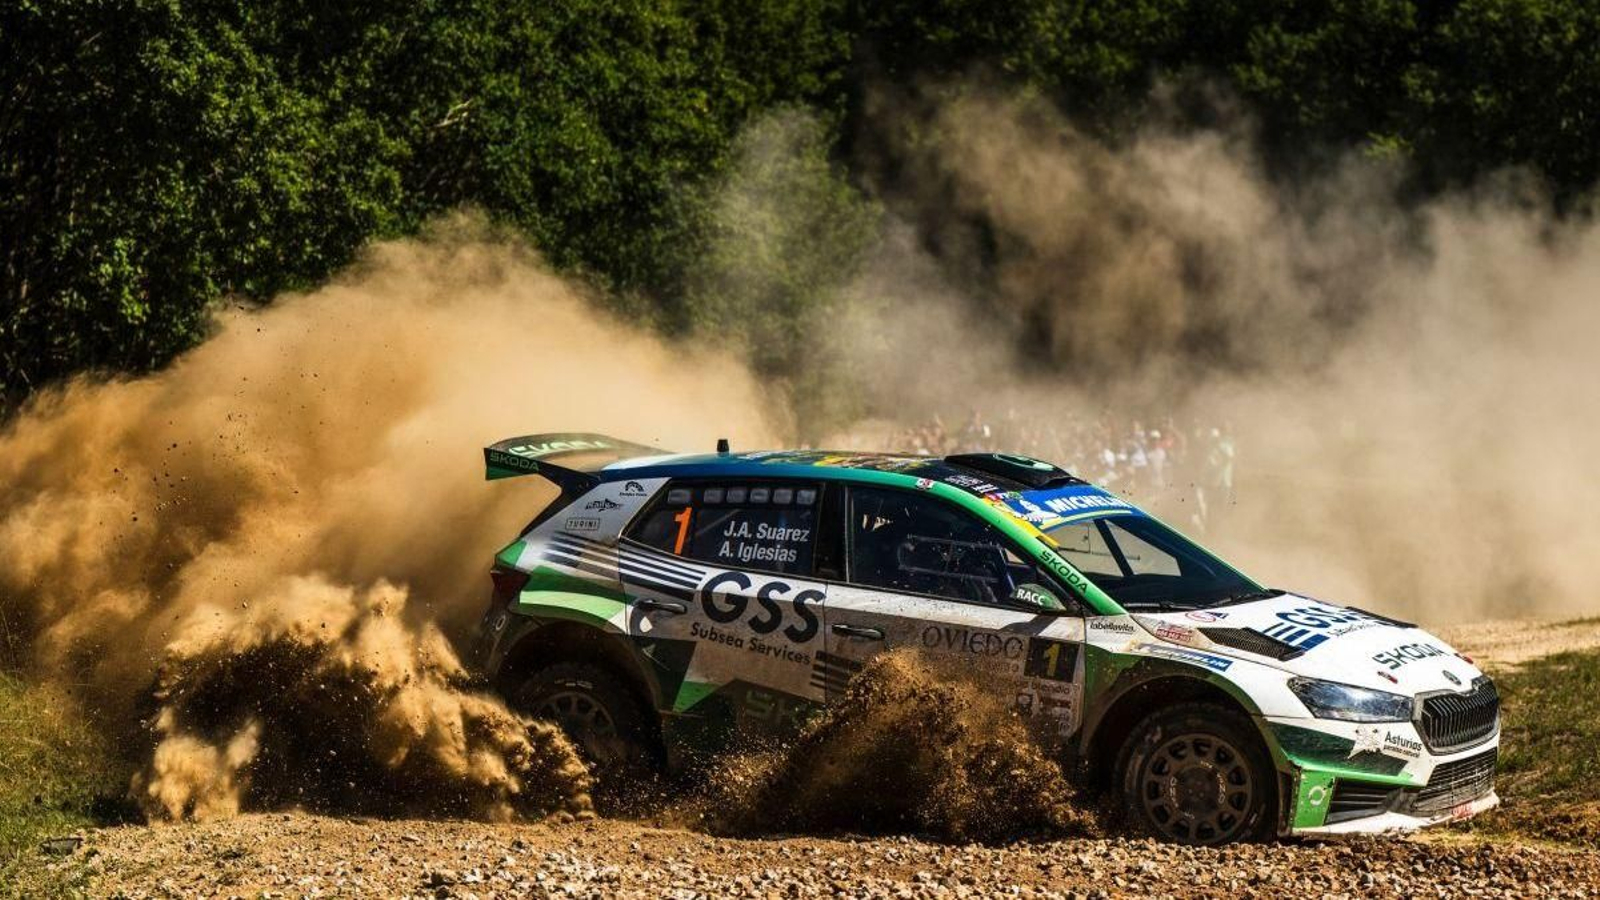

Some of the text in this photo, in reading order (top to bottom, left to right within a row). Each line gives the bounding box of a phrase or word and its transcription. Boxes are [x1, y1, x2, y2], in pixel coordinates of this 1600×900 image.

[673, 506, 693, 555] 1
[723, 520, 810, 542] J.A. Suarez
[718, 541, 797, 562] A. Iglesias
[701, 571, 827, 643] GSS
[1016, 588, 1046, 606] RACC
[690, 621, 811, 666] Subsea Services
[922, 625, 1024, 659] OVIEDO
[1043, 643, 1061, 677] 1
[1384, 730, 1423, 752] Asturias
